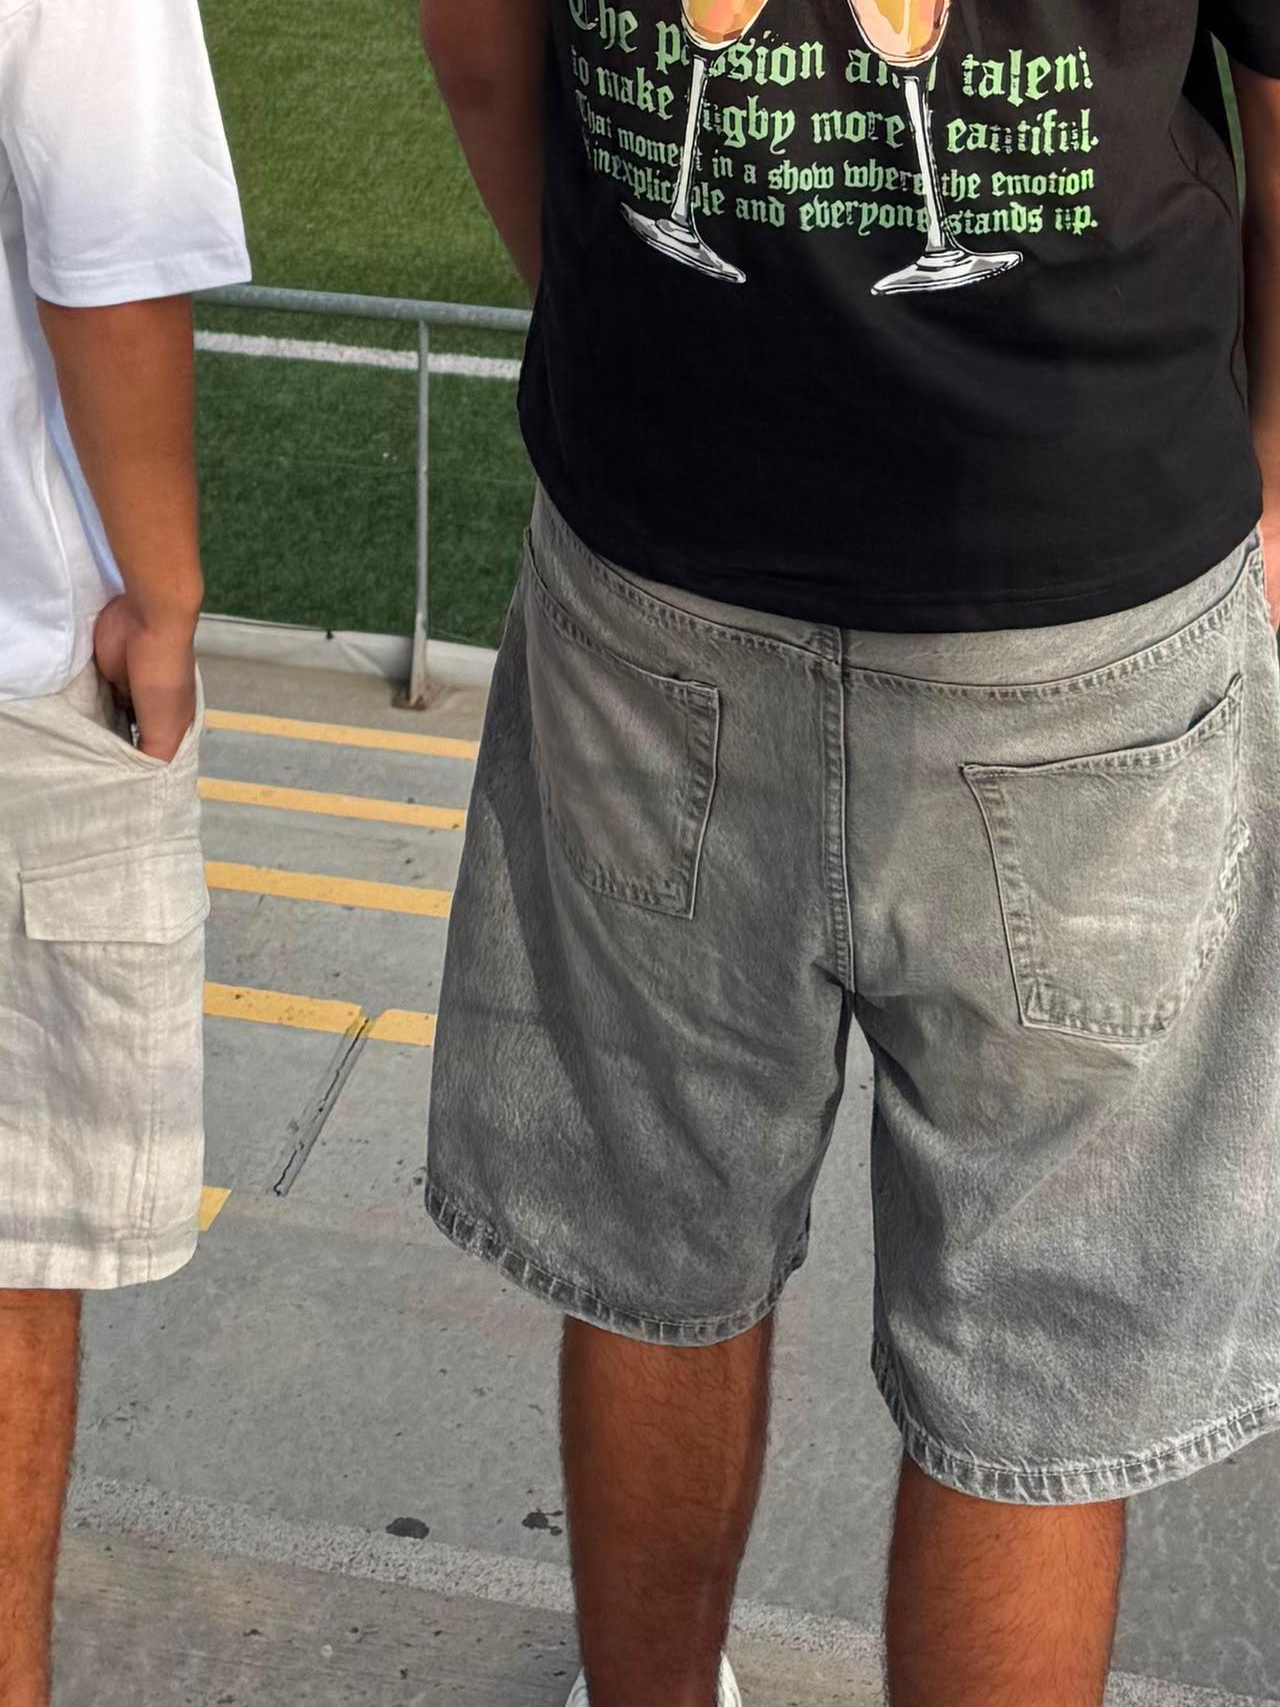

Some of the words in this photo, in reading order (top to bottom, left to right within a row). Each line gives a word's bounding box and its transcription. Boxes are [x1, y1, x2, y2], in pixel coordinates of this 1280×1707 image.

[845, 49, 937, 91] an
[596, 65, 675, 121] make
[685, 94, 795, 154] ugby
[811, 109, 905, 149] more
[929, 108, 1099, 155] eautiful.
[712, 149, 734, 178] in
[744, 164, 757, 184] a
[768, 160, 834, 195] show
[941, 169, 981, 202] the
[991, 167, 1094, 197] emotion
[736, 196, 785, 228] and
[947, 201, 1043, 235] stands
